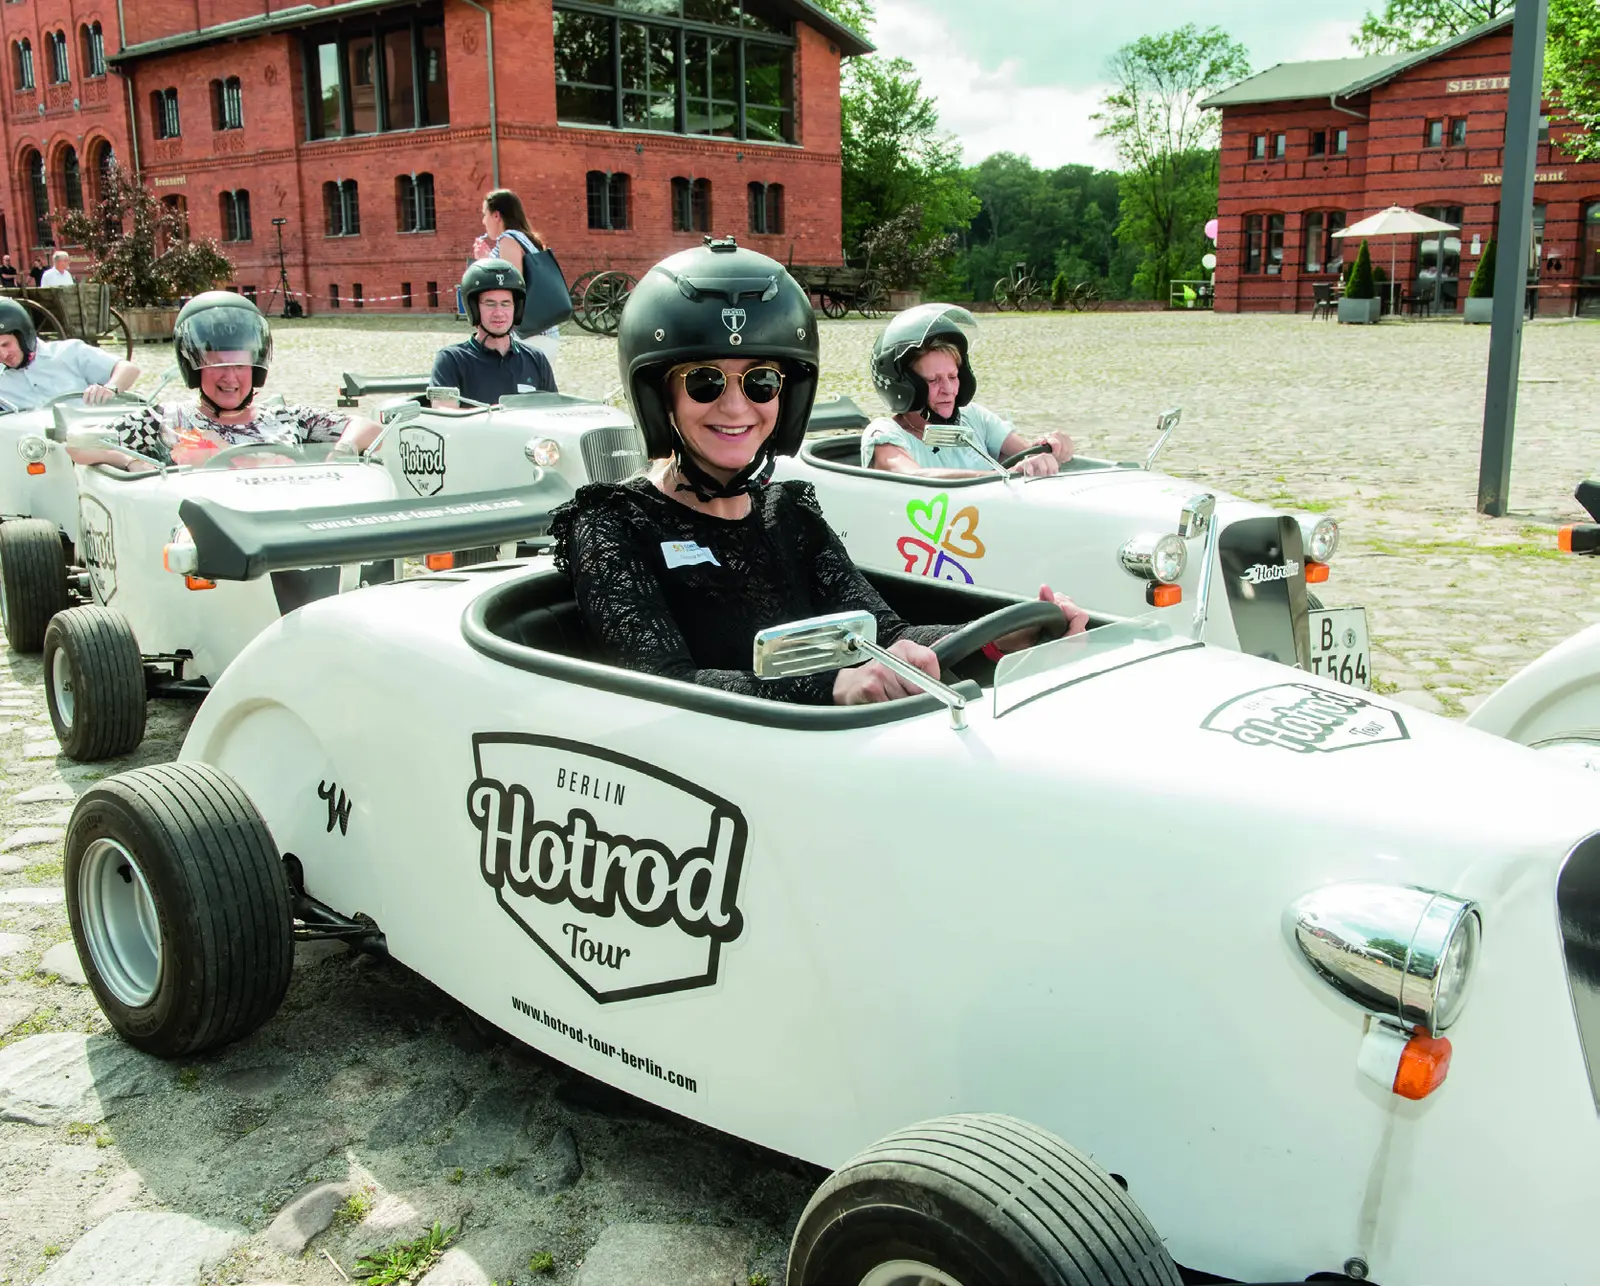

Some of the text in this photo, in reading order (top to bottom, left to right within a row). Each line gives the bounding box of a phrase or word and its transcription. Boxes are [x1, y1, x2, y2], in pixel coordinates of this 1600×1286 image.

[1483, 171, 1564, 185] Rerant
[399, 437, 446, 475] Hotrod
[308, 498, 524, 531] www.hotrod-tour-berlin.com
[1321, 617, 1333, 652] B
[557, 768, 626, 806] BERLIN
[469, 780, 746, 938] Hotrod
[562, 922, 631, 971] Tour
[511, 995, 698, 1094] www.hotrod-tour-berlin.com
